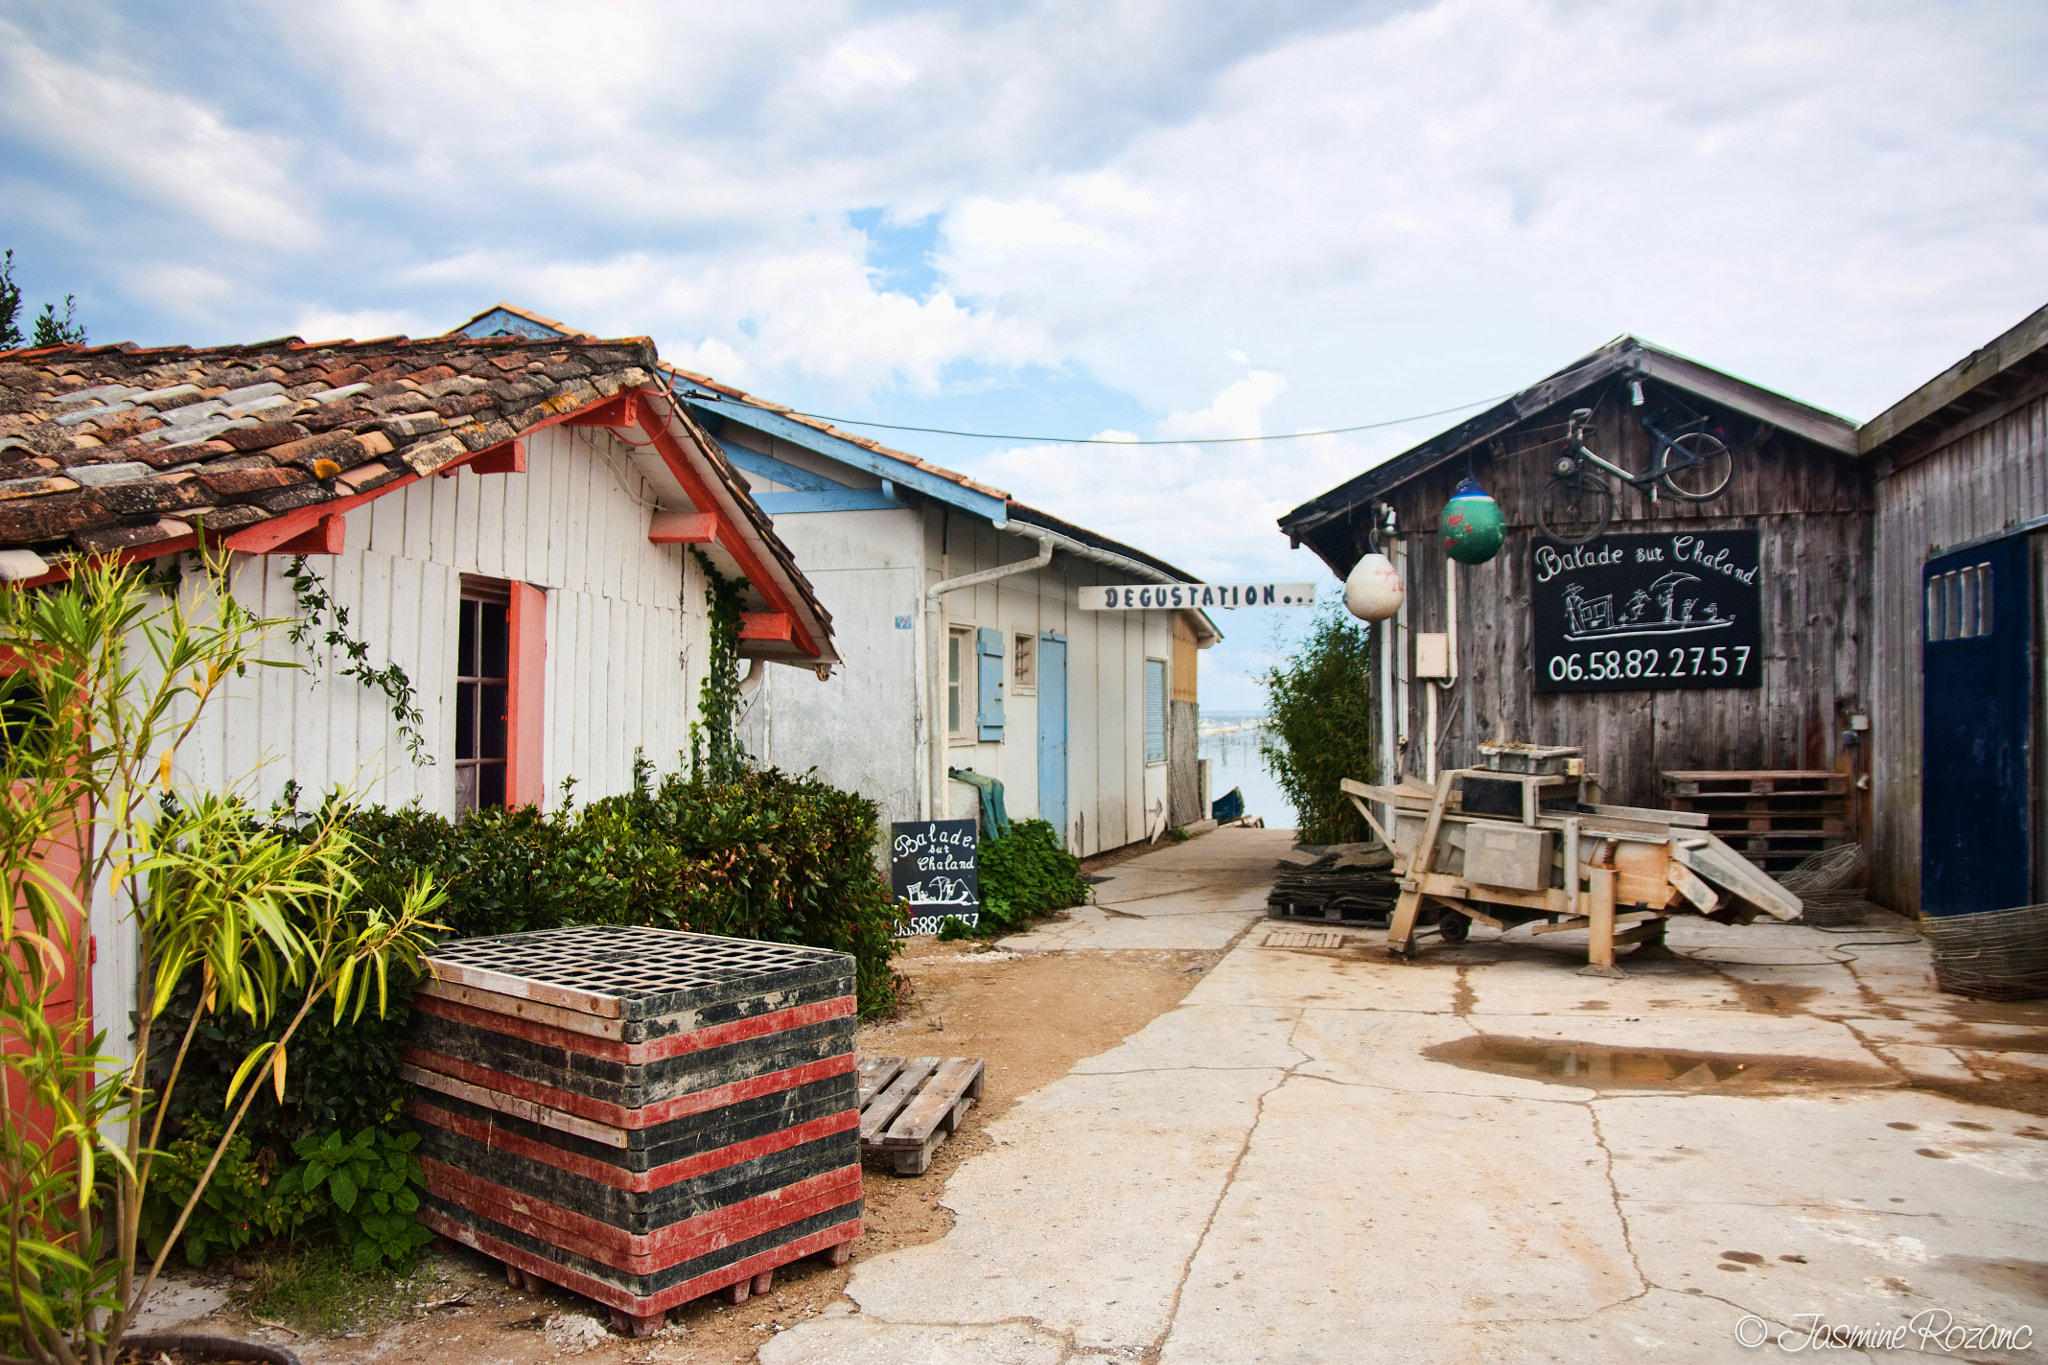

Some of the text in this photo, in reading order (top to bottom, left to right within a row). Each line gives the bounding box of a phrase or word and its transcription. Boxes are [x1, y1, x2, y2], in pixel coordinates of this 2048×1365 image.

[1535, 535, 1759, 586] Balade sur Chaland
[1549, 646, 1751, 681] 06.58.82.27.57
[917, 853, 975, 871] Chaland
